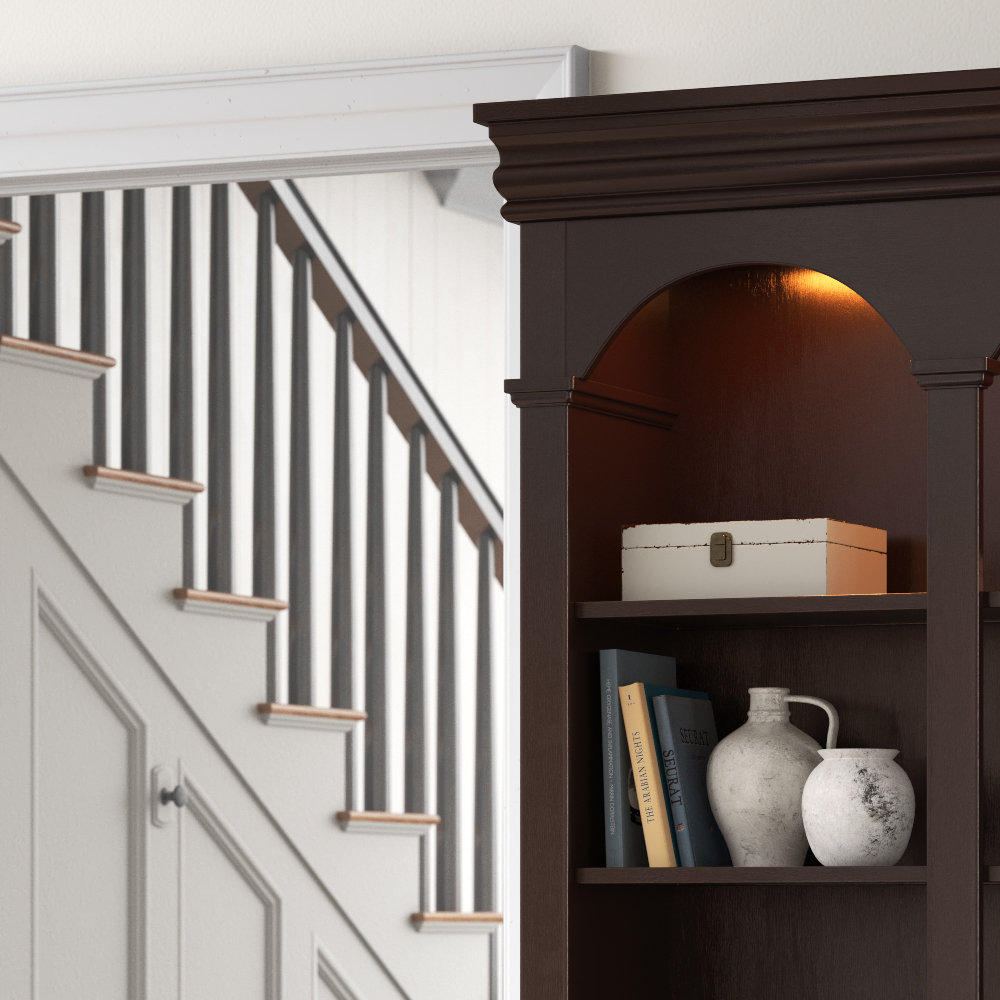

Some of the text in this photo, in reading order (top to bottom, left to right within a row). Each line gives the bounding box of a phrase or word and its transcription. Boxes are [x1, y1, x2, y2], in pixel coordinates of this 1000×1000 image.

[631, 731, 655, 824] THE ARABIAN NIGHTS
[663, 749, 682, 806] SEURAT
